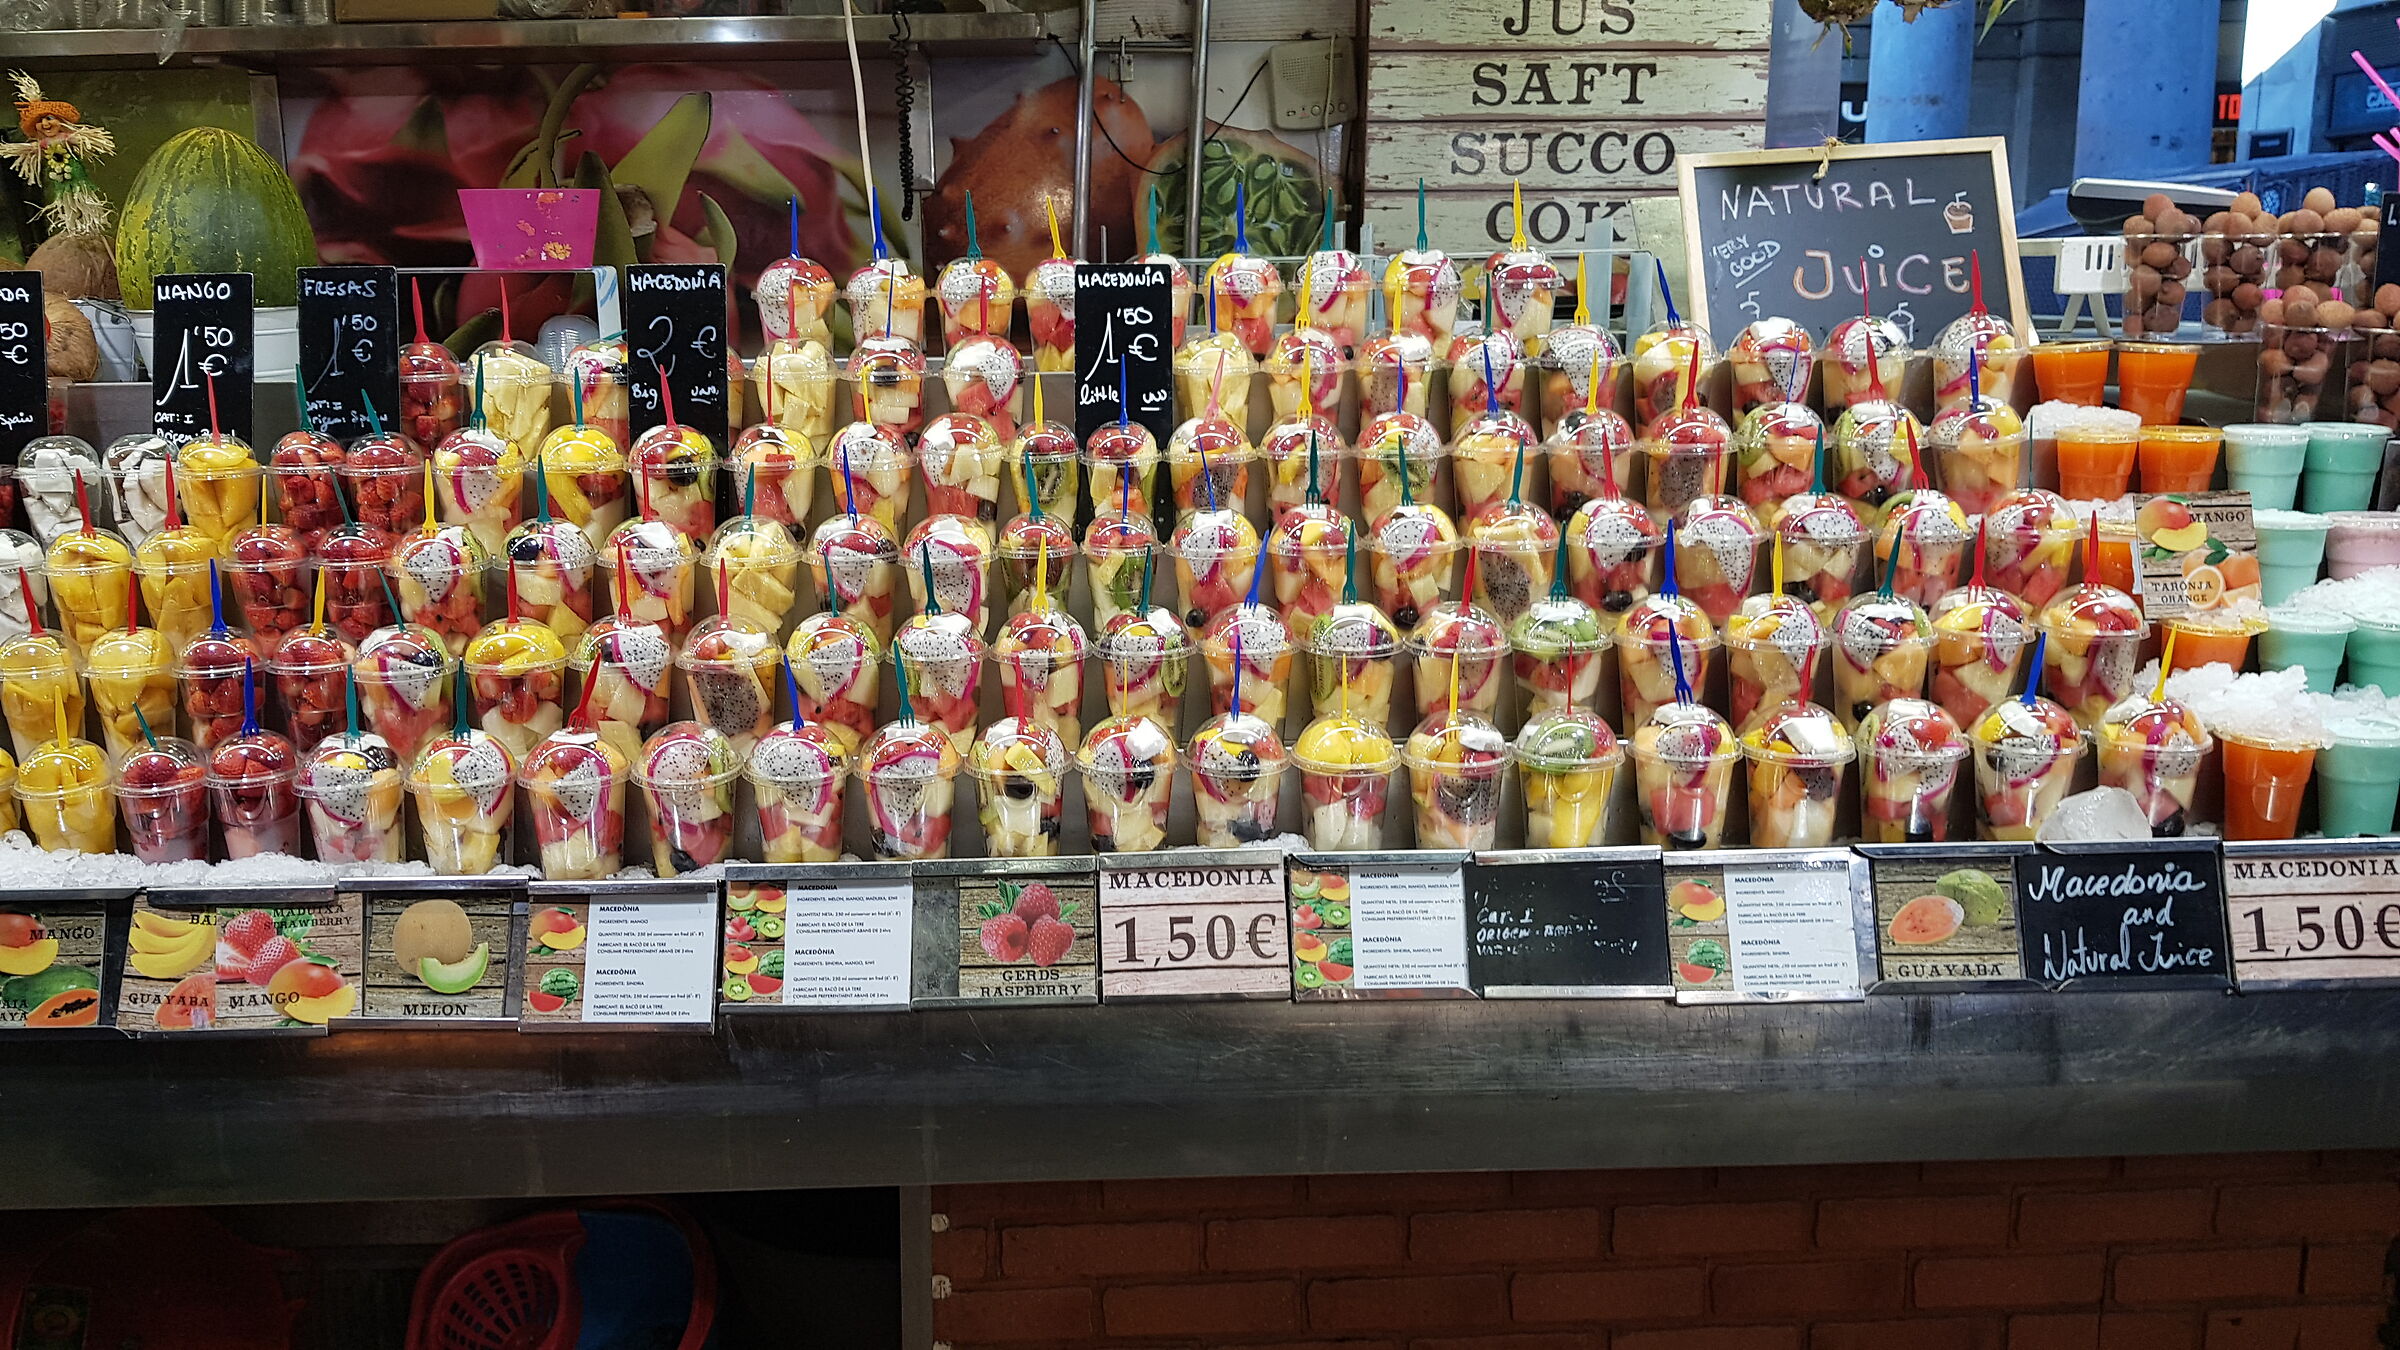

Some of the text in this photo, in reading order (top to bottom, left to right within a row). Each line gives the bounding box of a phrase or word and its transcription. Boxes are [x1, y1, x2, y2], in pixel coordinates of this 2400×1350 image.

[1472, 62, 1657, 106] SAFT
[1451, 132, 1675, 176] SUCCO
[1722, 179, 1935, 221] NATURAL
[1730, 240, 1780, 277] GOOD
[157, 283, 230, 301] MANGO
[304, 280, 377, 298] FRESAS
[352, 339, 373, 362] €
[637, 316, 717, 377] 2 €
[1128, 333, 1159, 361] €
[198, 354, 228, 376] €
[631, 383, 658, 409] Big
[1080, 384, 1120, 405] little
[2189, 511, 2245, 523] MANGO
[2152, 581, 2213, 592] TARONJA
[2161, 594, 2207, 604] ORANGE
[1109, 868, 1276, 890] MACEDONIA
[2233, 859, 2400, 880] MACEDONIA
[2029, 862, 2206, 902] Macedonia
[2123, 896, 2174, 927] and
[29, 926, 94, 941] MANGO
[264, 916, 352, 930] STRAWBERRY
[2243, 904, 2400, 957] 1,50€
[1115, 913, 1279, 968] 1,50€
[2044, 920, 2214, 982] Natural Juice
[1002, 969, 1060, 982] GERDS
[1899, 964, 2002, 978] GUAYABA
[128, 992, 209, 1007] GUAYABA
[229, 991, 299, 1009] MANGO
[980, 984, 1082, 998] RASPBERRY
[402, 1003, 468, 1016] MELON
